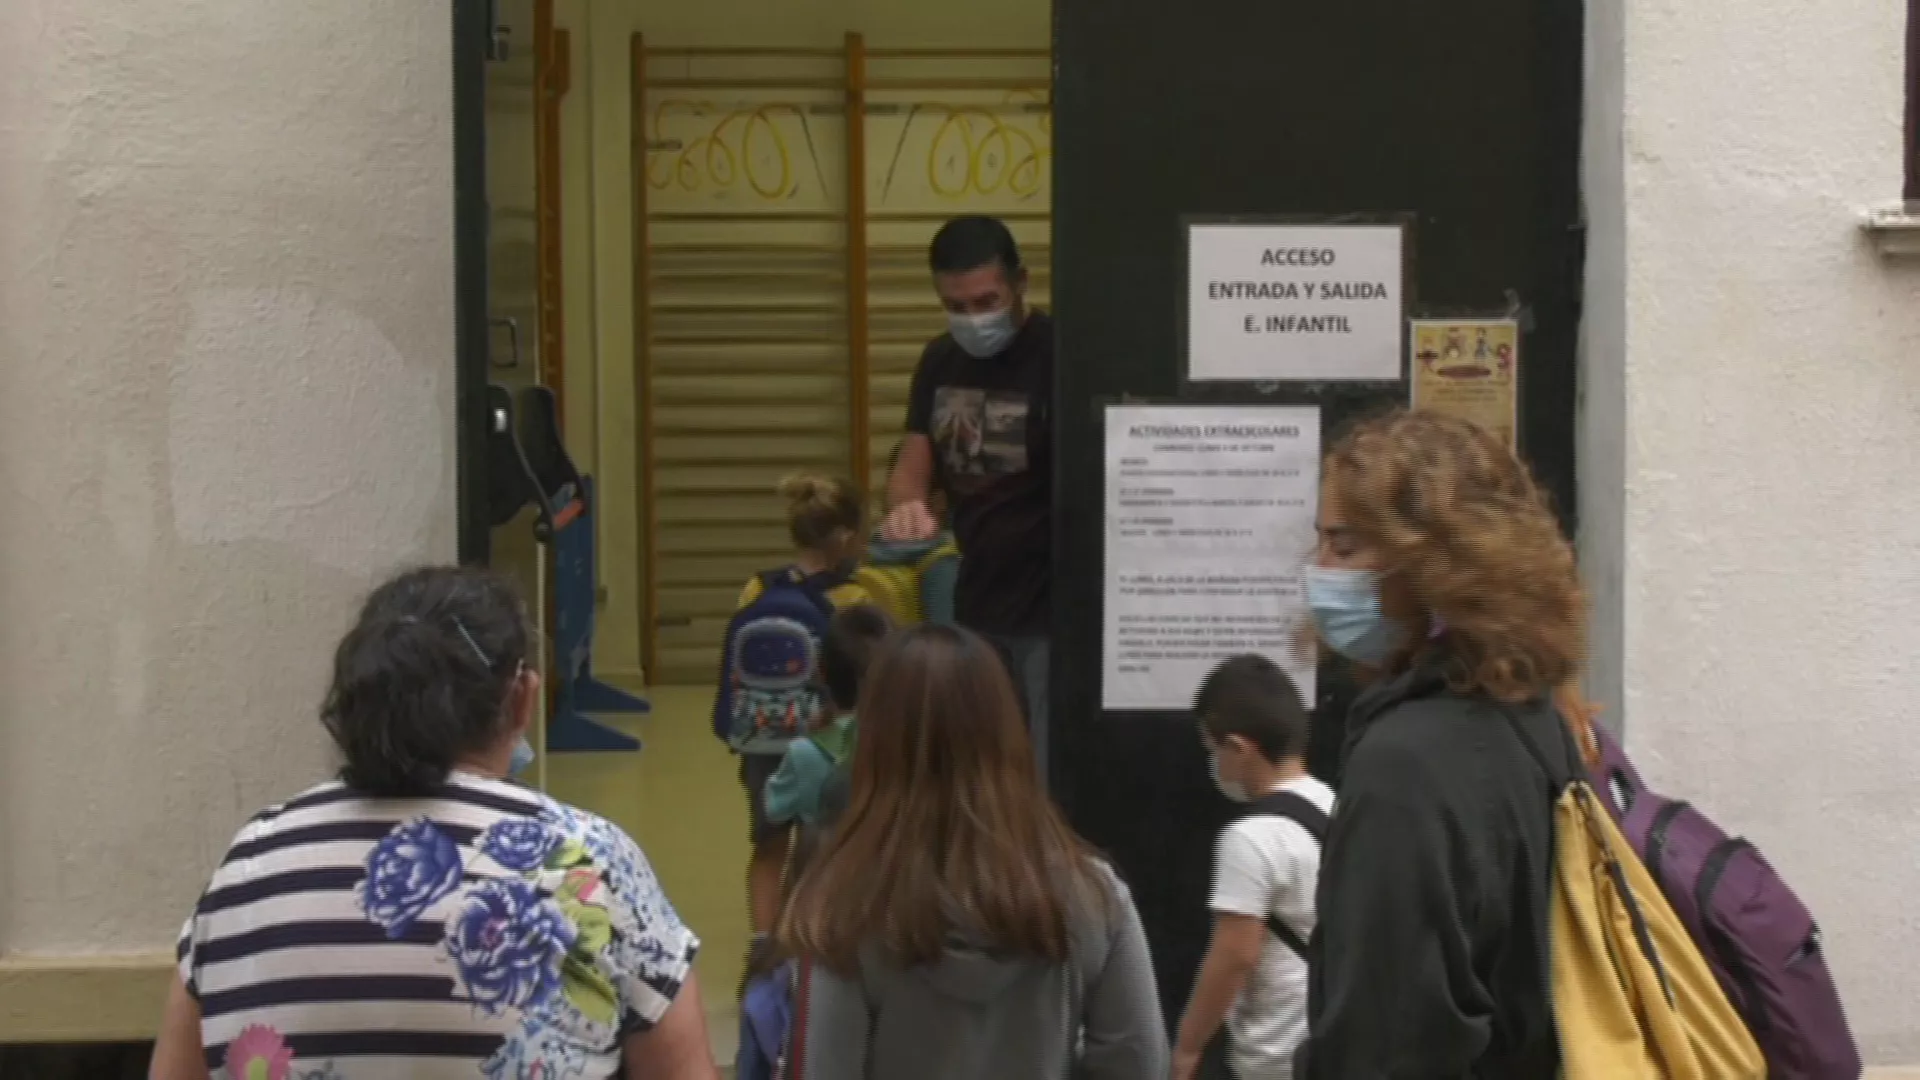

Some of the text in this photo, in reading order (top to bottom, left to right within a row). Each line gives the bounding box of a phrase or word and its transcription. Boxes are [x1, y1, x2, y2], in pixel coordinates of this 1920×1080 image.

[1260, 248, 1336, 266] ACCESO
[1208, 281, 1388, 300] ENTRADA Y SALIDA
[1244, 315, 1352, 333] E. INFANTIL
[1129, 425, 1202, 439] ACTIVIDADES
